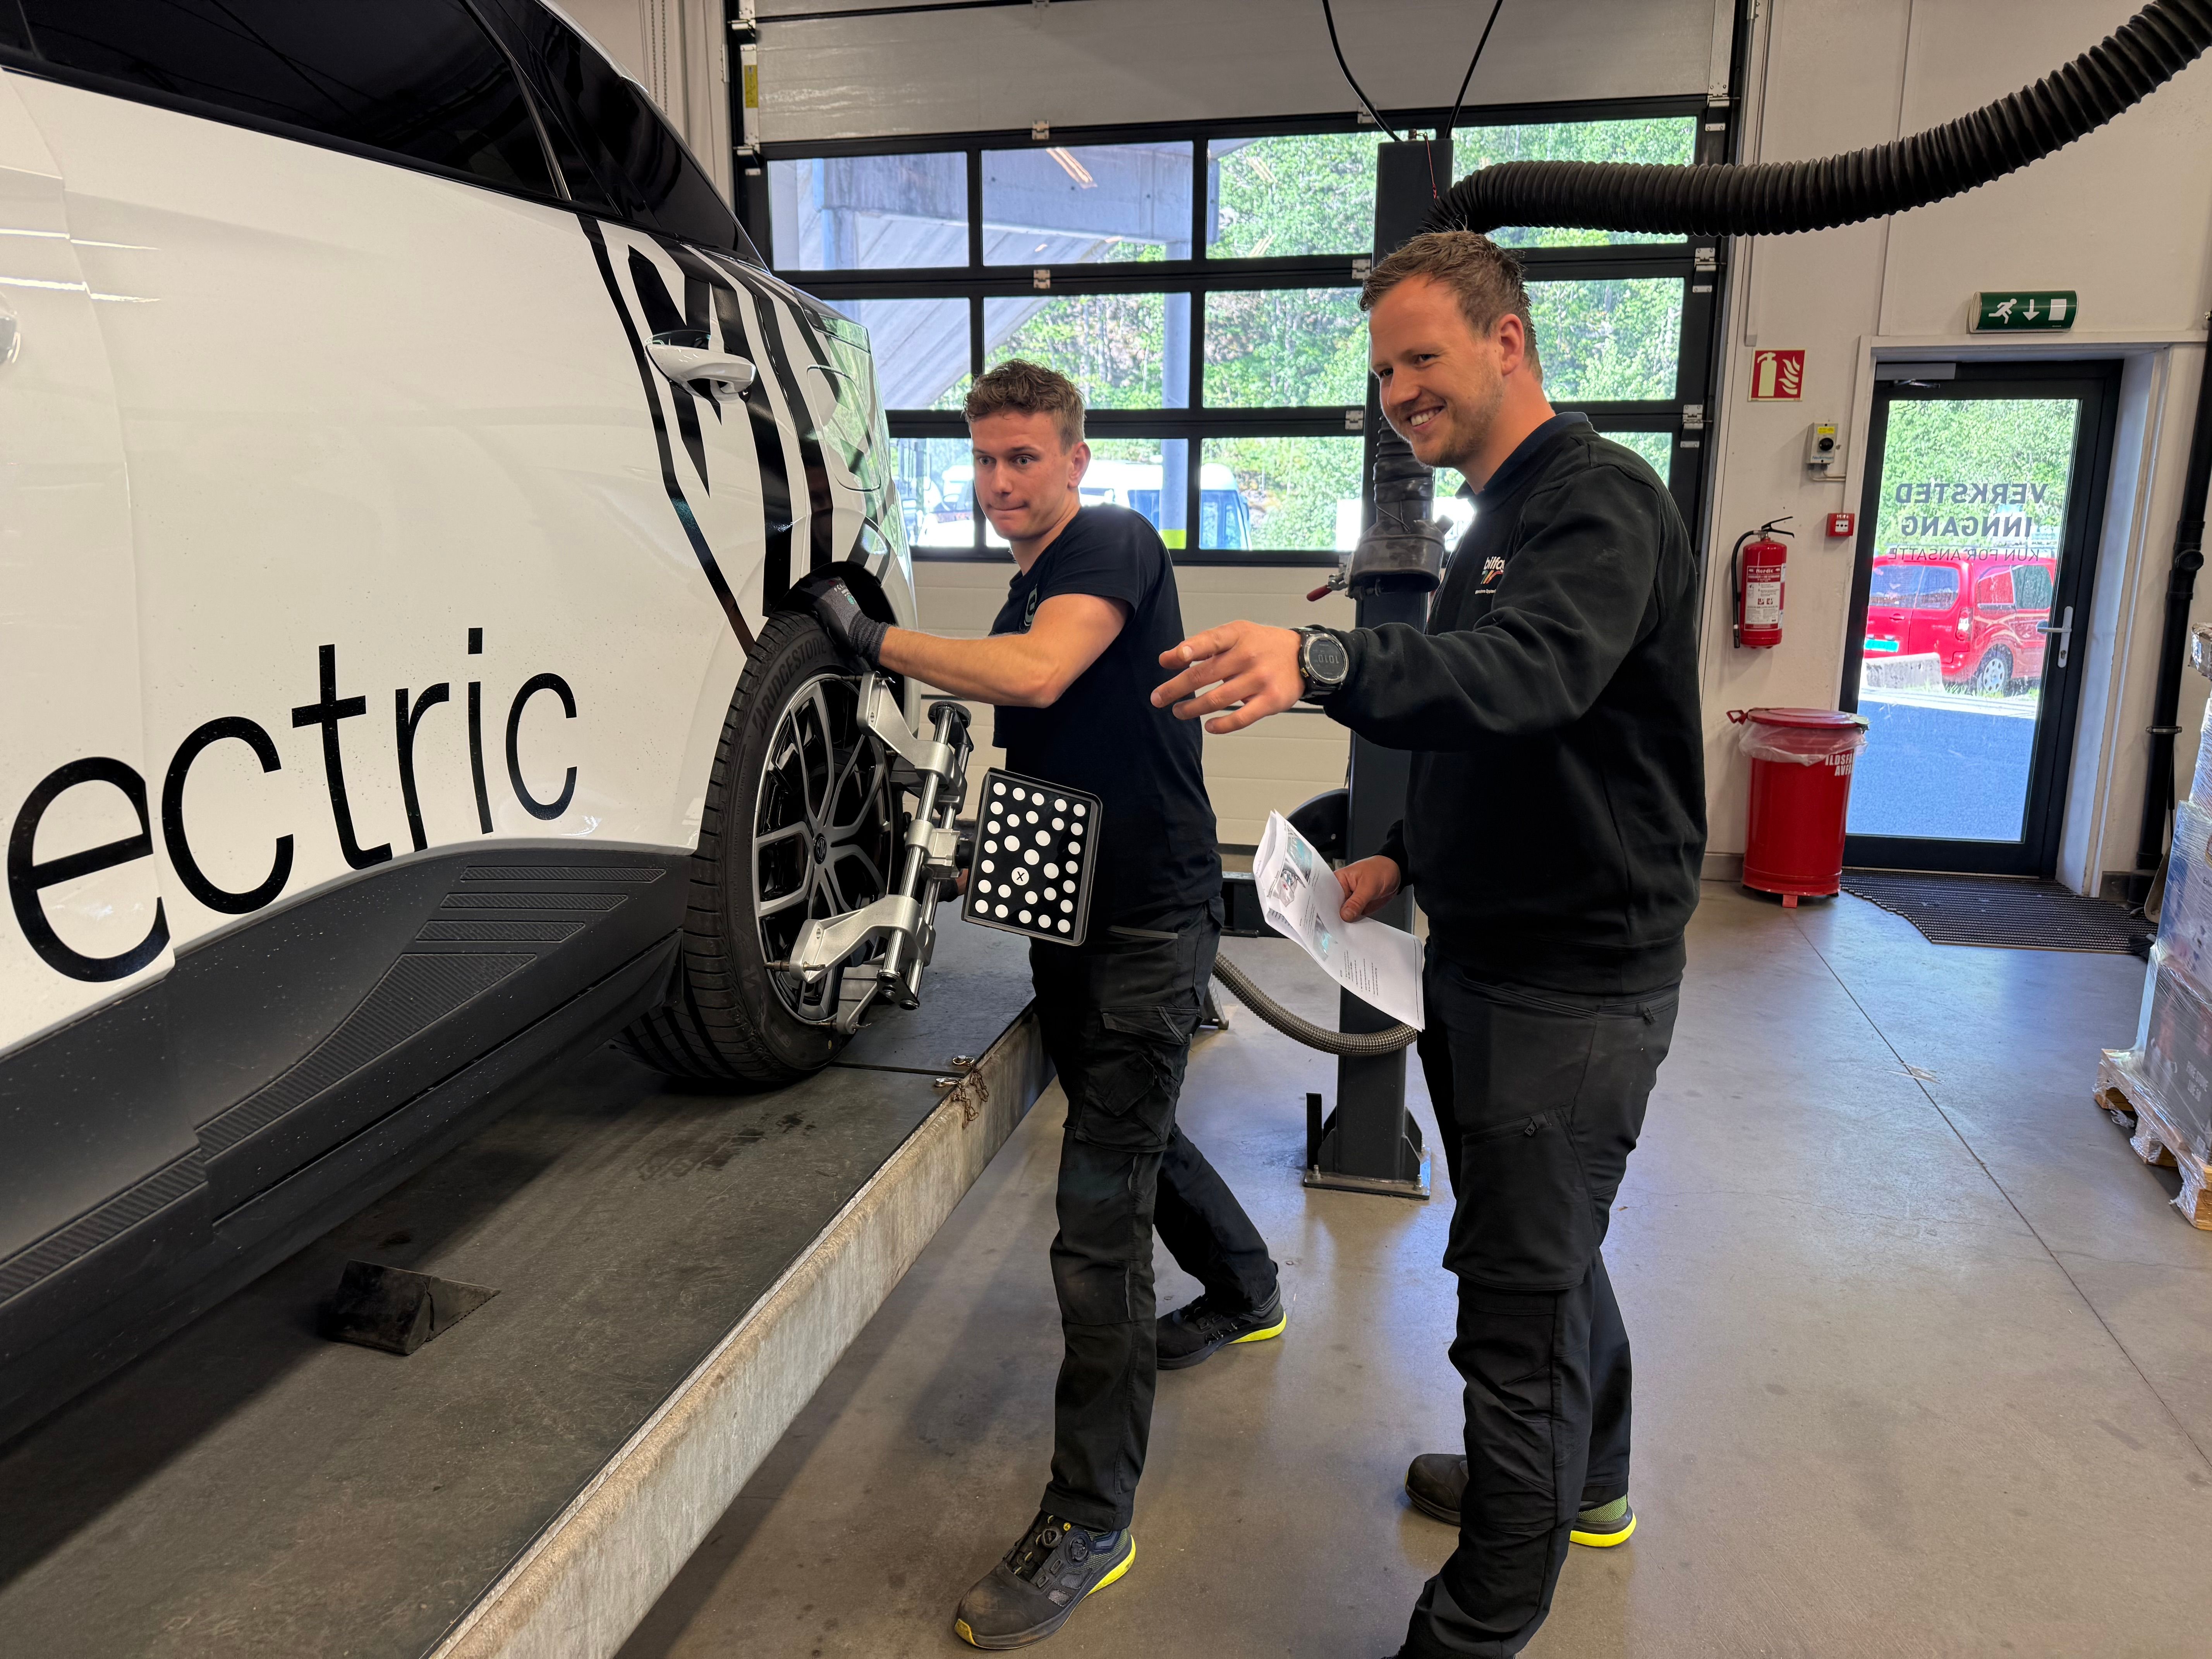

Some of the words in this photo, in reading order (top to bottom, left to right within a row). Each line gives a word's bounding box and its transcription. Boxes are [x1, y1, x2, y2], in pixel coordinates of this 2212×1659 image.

[1483, 556, 1505, 573] bilfa
[752, 637, 827, 736] BRIDGESTONE
[7, 627, 578, 983] ectric
[1016, 871, 1025, 882] X
